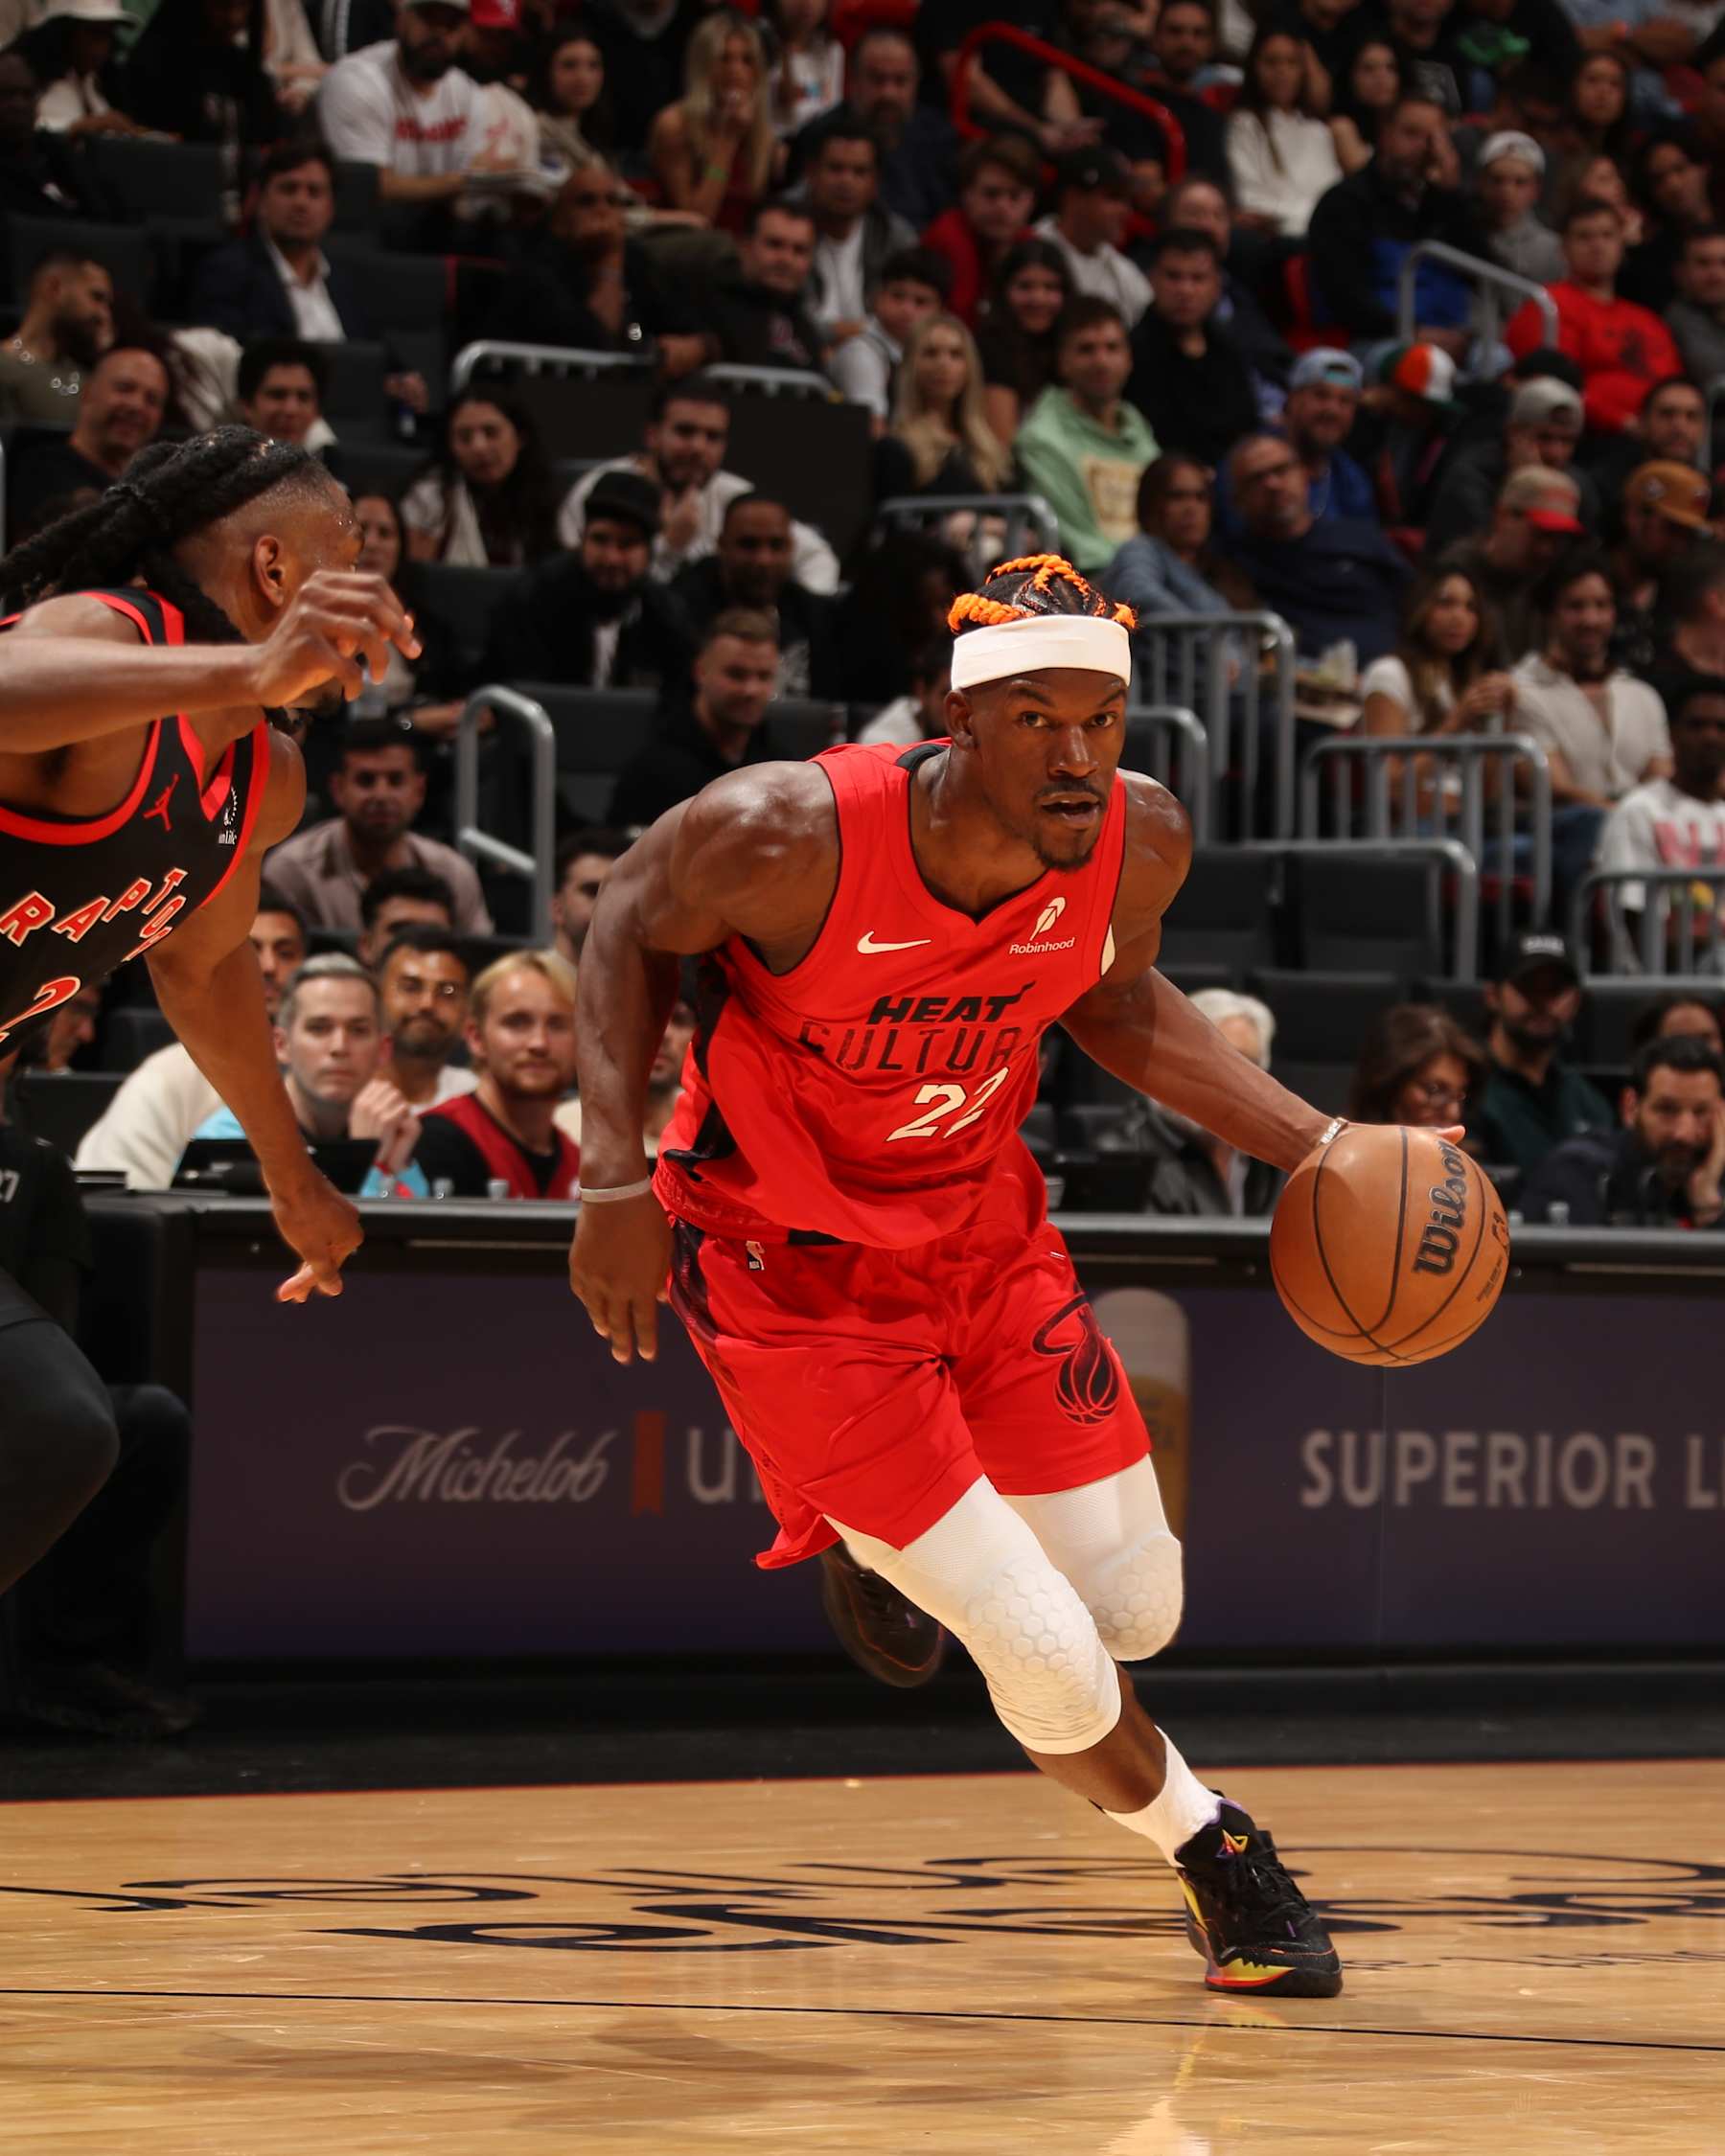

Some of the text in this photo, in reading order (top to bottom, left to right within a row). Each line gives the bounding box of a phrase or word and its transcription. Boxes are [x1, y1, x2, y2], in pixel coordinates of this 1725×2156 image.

[1009, 937, 1075, 955] Robinhood
[866, 981, 1036, 1025] HEAT
[886, 1066, 1009, 1142] 22
[0, 1167, 20, 1204] 7
[337, 1426, 618, 1510] Michelob
[1300, 1431, 1725, 1510] SUPERIOR L
[301, 1889, 1725, 1955] aseya
